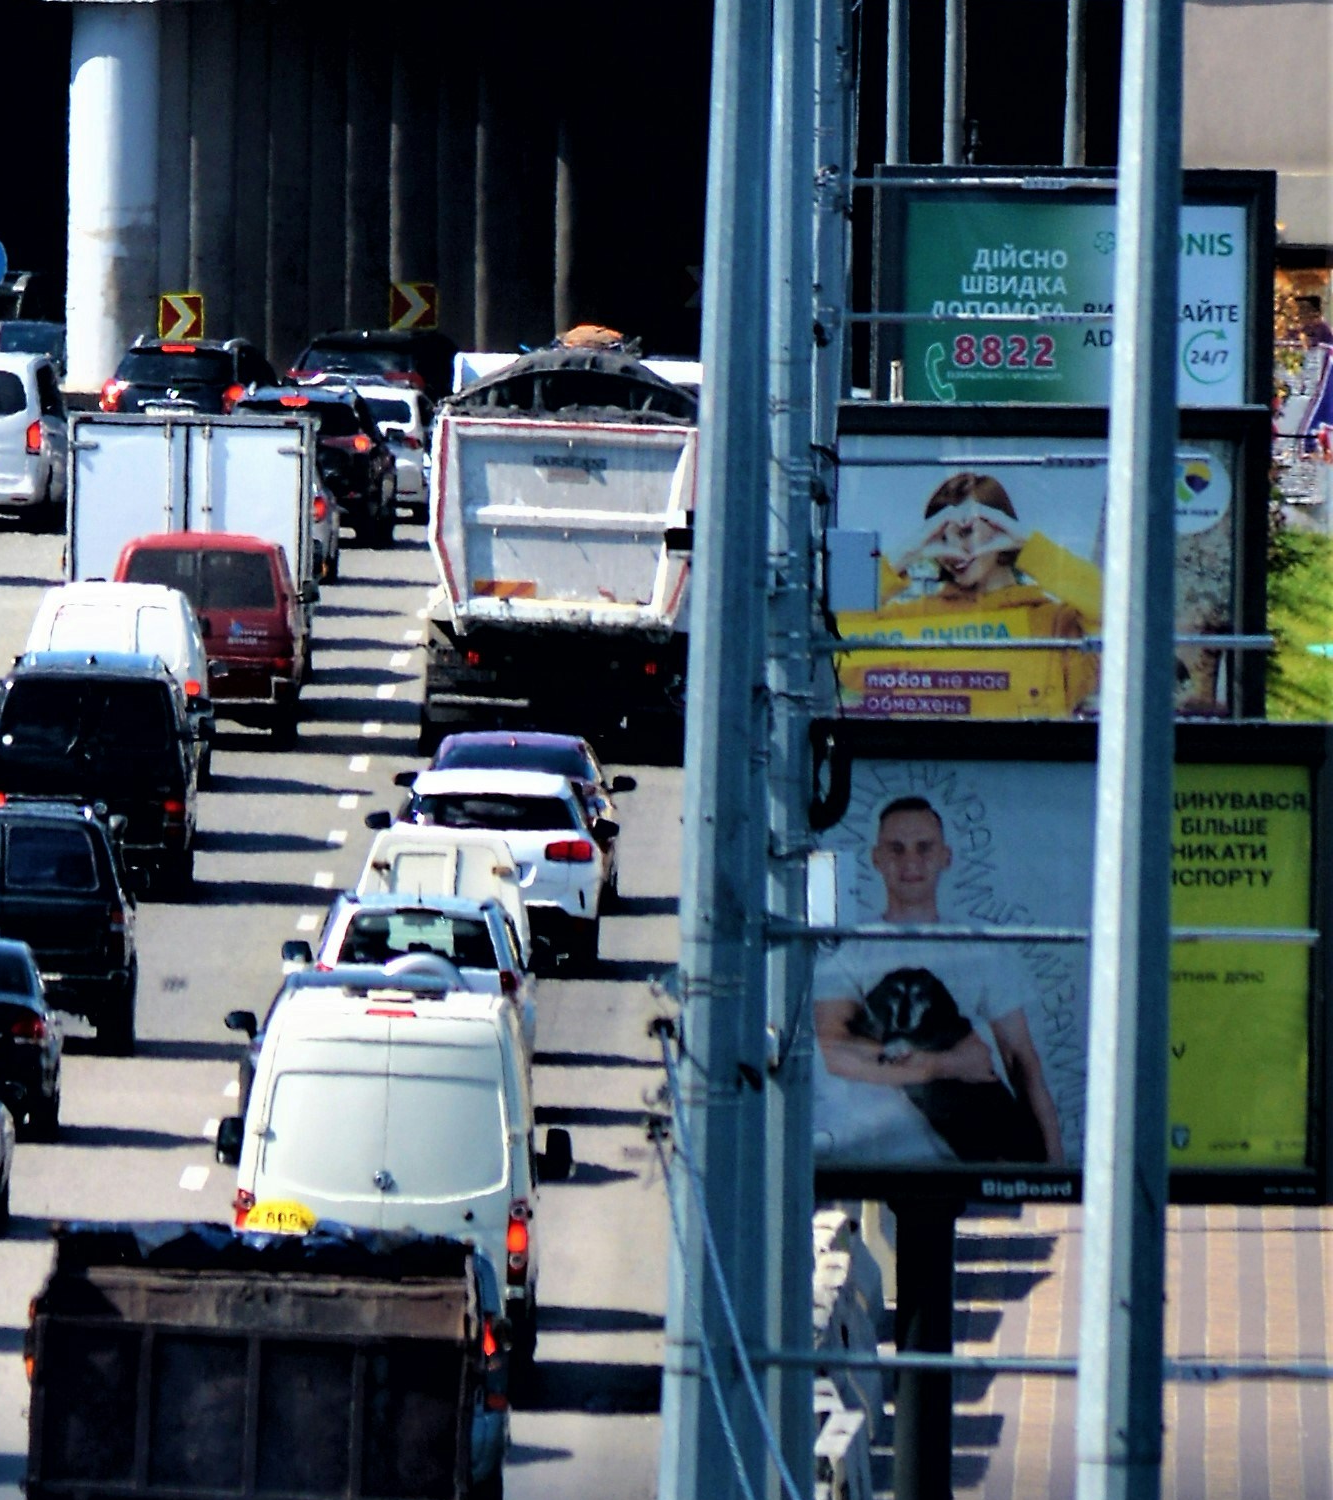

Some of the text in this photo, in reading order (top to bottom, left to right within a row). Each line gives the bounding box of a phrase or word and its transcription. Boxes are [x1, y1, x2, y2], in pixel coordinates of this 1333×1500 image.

[1179, 232, 1234, 257] NIS
[973, 243, 1068, 272] ДІЙСНО
[962, 275, 1068, 298] ШВИДКА
[932, 301, 1066, 323] ДОПОМОГА
[953, 334, 1056, 368] 8822
[1190, 350, 1229, 366] 24/7
[867, 671, 1007, 689] любов не має
[867, 696, 966, 713] обмежень
[1181, 817, 1268, 836] БІЛЬШЕ
[981, 1179, 1072, 1199] BigBoard
